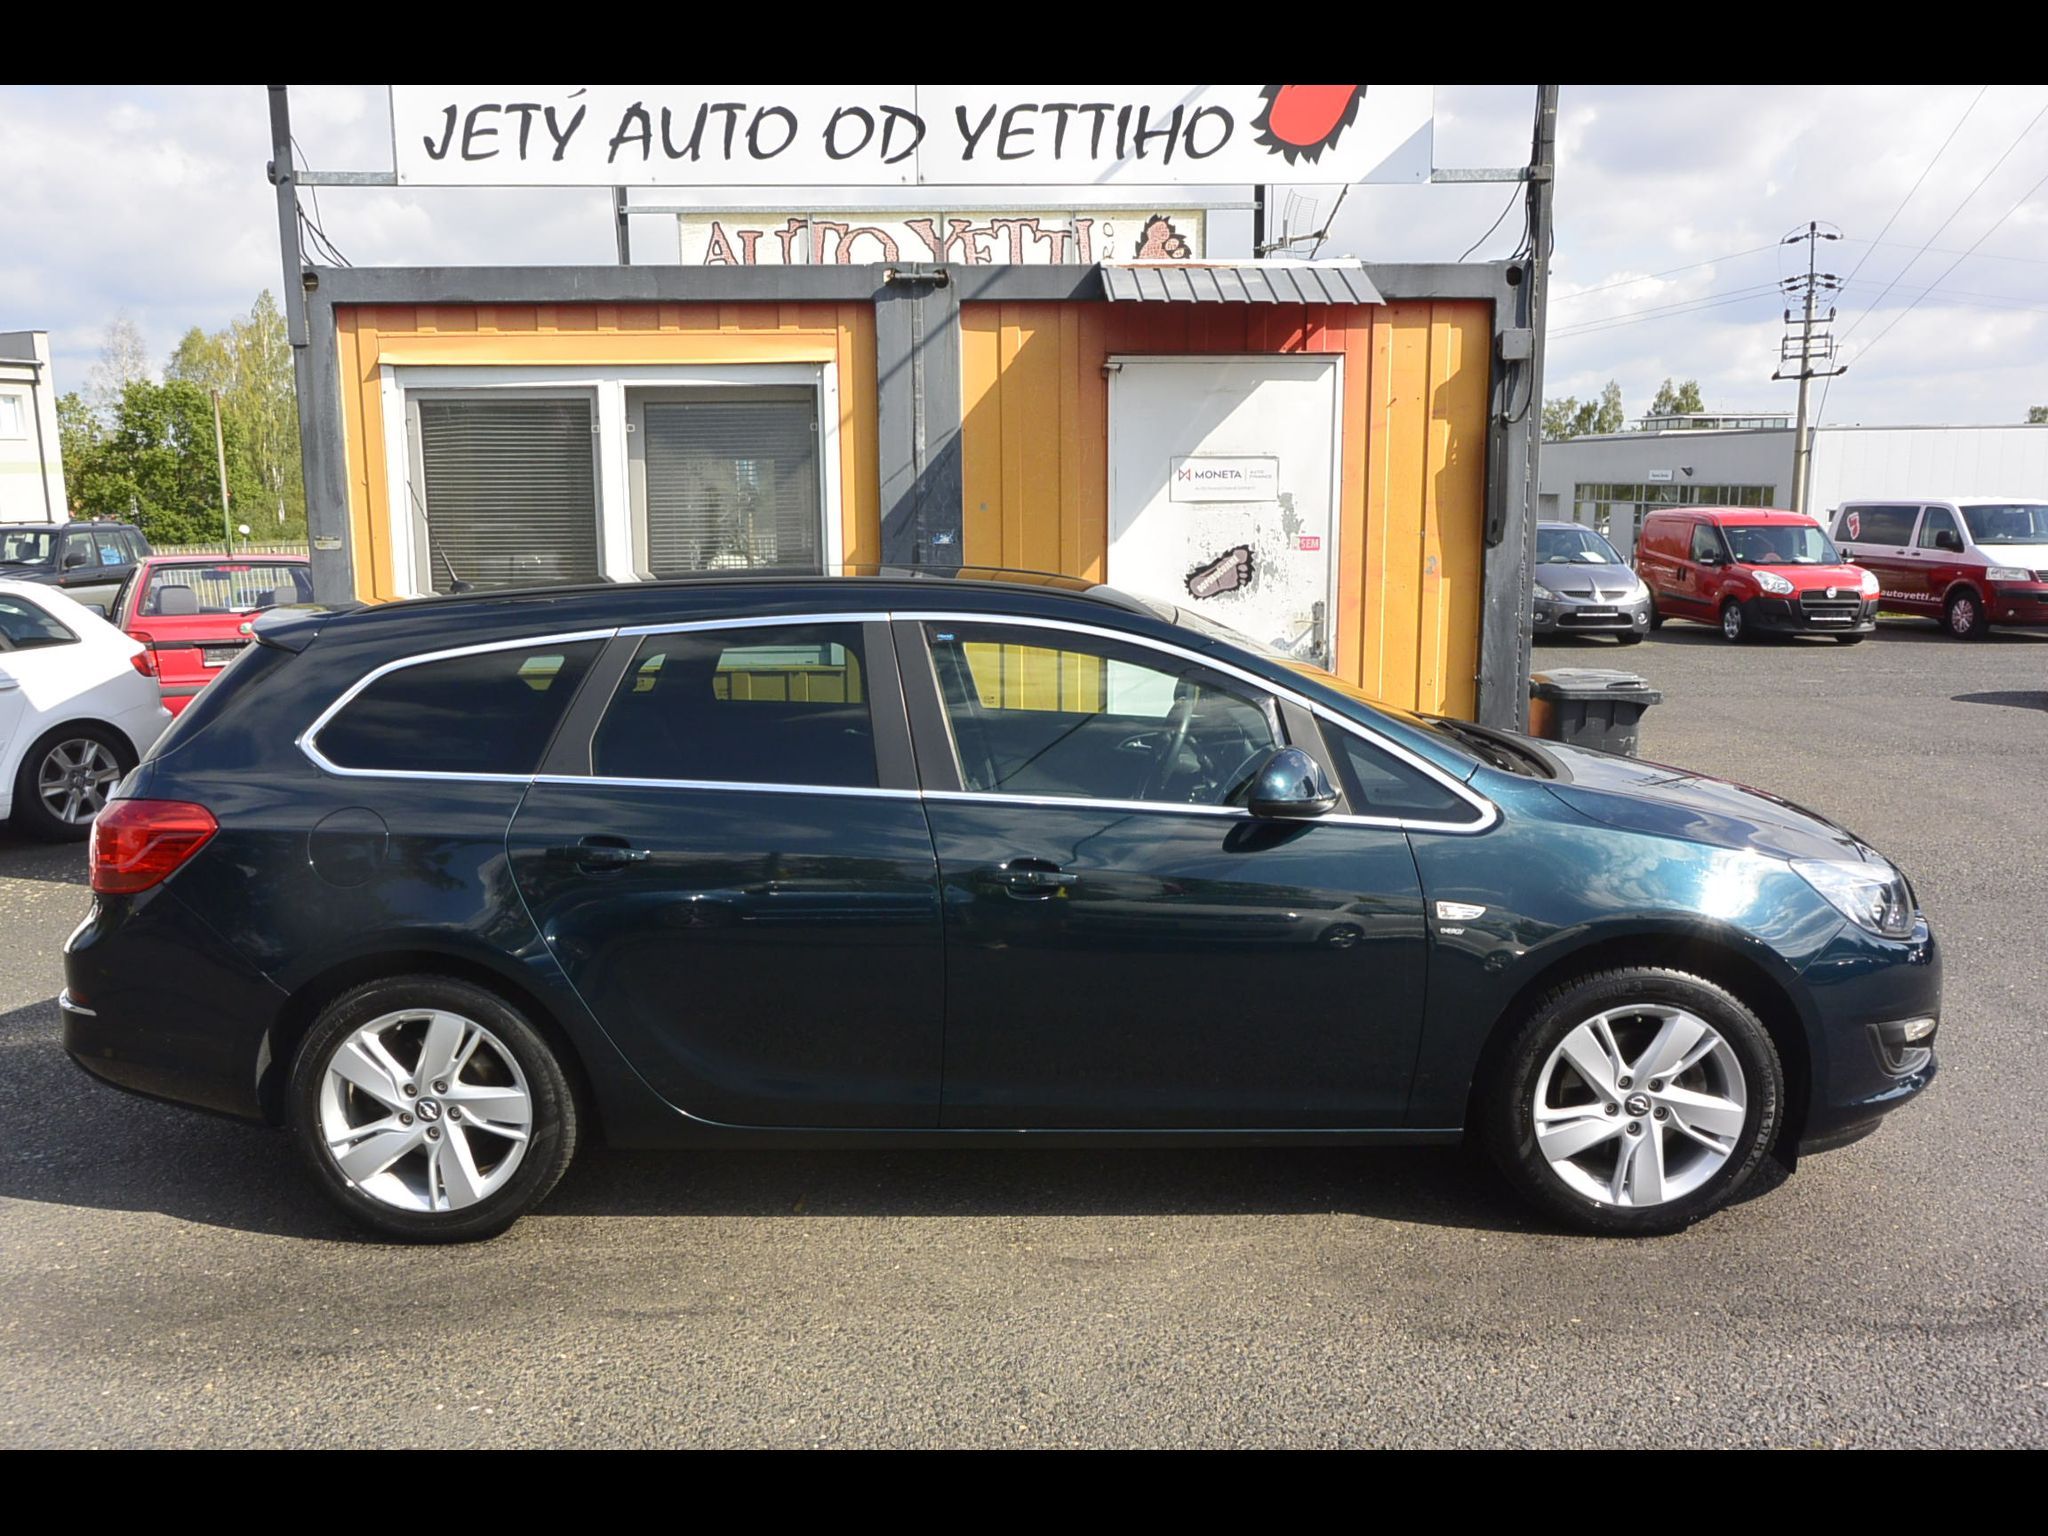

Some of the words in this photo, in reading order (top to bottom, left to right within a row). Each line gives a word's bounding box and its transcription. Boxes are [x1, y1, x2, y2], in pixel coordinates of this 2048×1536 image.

[424, 88, 587, 161] JETÝ
[609, 102, 798, 163] AUTO
[823, 106, 926, 164] OD
[956, 104, 1234, 165] YETTIHO
[1195, 470, 1242, 479] MONETA
[1300, 537, 1319, 549] SEM
